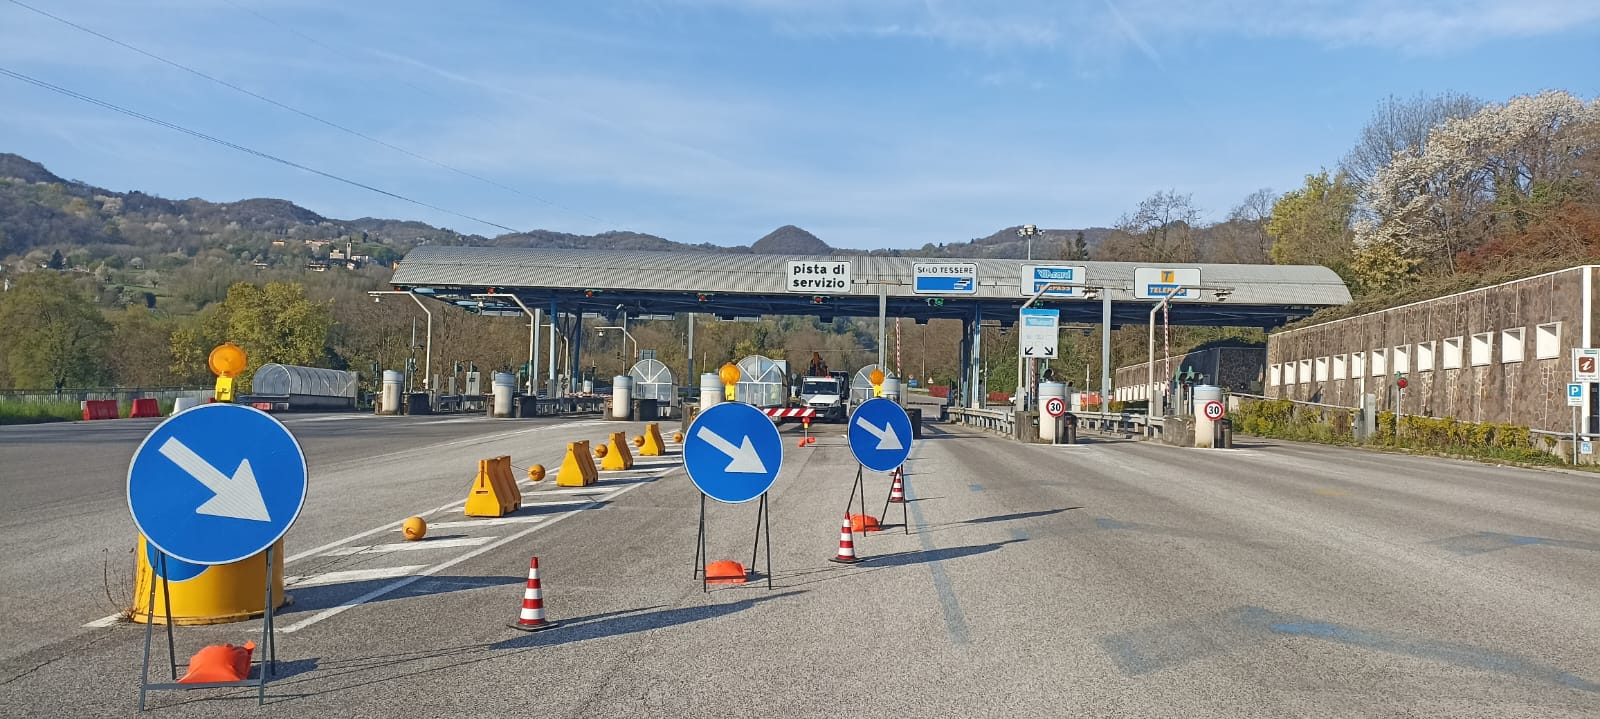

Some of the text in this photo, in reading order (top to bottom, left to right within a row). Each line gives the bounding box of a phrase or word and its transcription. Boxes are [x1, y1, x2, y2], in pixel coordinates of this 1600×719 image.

[793, 263, 845, 275] pista di
[917, 266, 938, 274] SOLO
[792, 278, 845, 288] servizio
[1571, 386, 1579, 396] P
[1050, 402, 1061, 411] 30
[1208, 405, 1220, 415] 30
